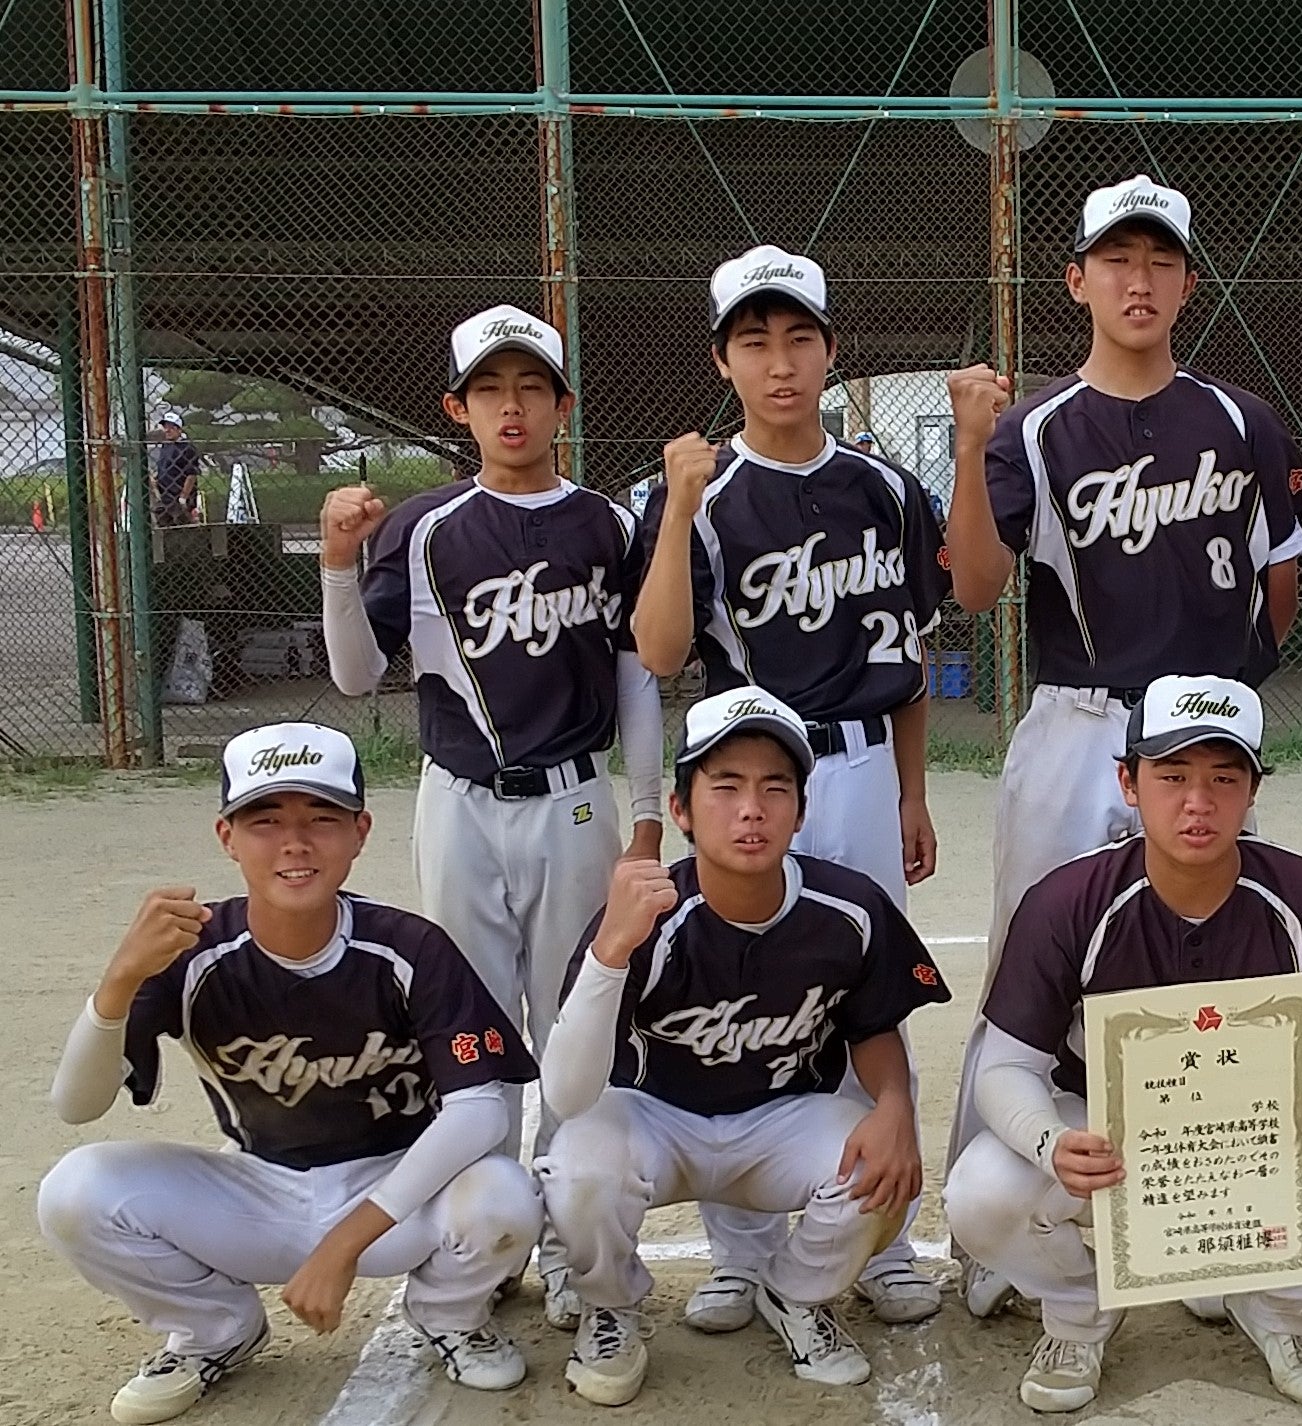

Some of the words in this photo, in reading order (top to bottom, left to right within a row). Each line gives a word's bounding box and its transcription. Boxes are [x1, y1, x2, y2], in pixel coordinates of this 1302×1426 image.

[1109, 188, 1169, 214] Hyuko
[740, 260, 804, 288] Hyuko
[480, 317, 543, 344] Hyuko
[1069, 449, 1255, 555] Hyuko
[1206, 536, 1236, 590] 8
[737, 531, 906, 632] Hyuko
[861, 610, 922, 665] 28
[1171, 690, 1242, 721] Hyuko
[247, 743, 324, 777] Hyuko
[1251, 1099, 1280, 1113] 学校
[1138, 1127, 1167, 1141] 令和
